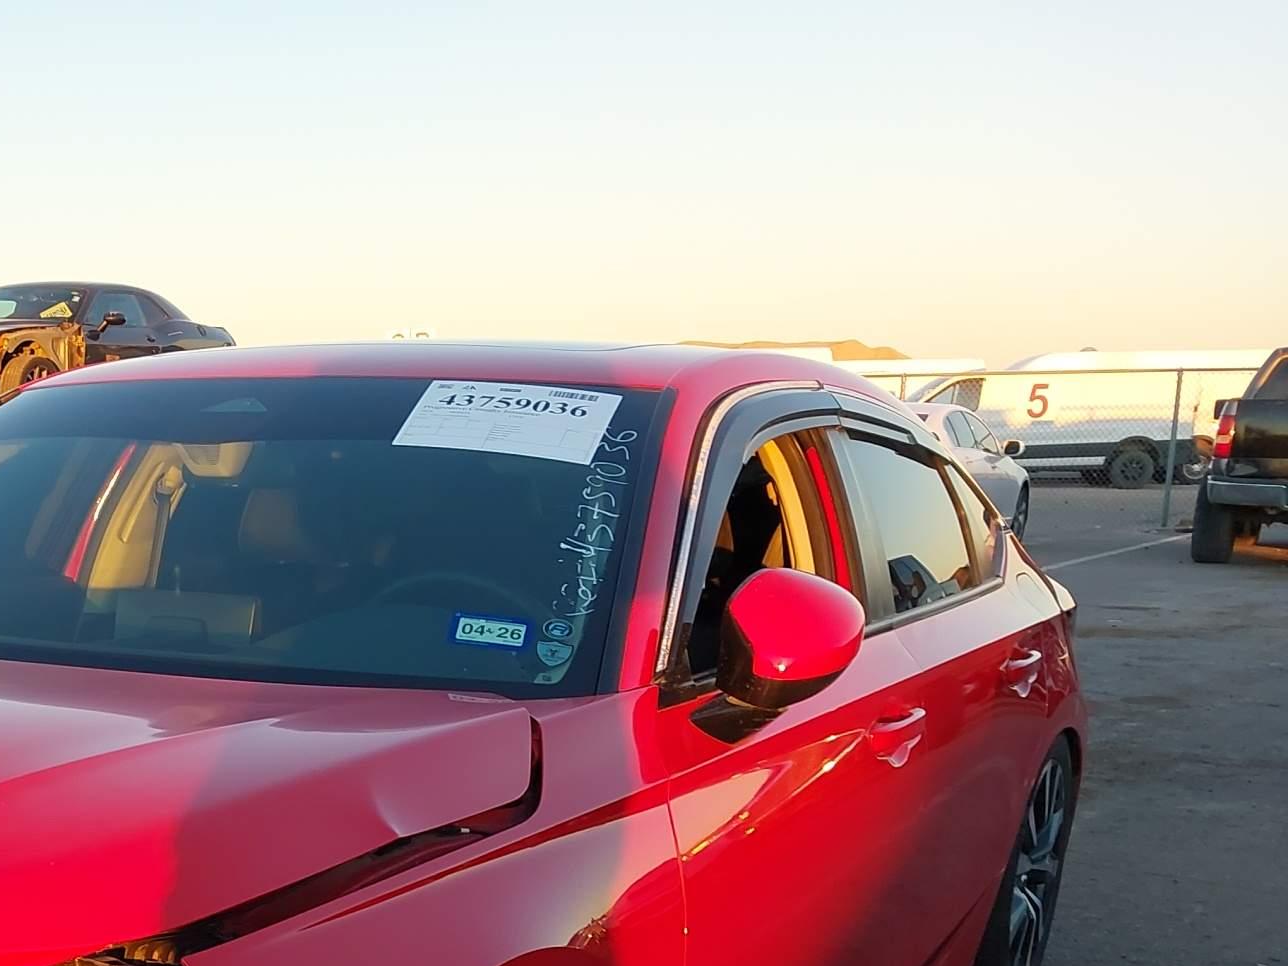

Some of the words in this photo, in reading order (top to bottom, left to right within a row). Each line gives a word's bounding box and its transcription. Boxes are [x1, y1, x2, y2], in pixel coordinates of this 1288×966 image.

[439, 394, 590, 418] 43759036
[1026, 383, 1050, 418] 5
[462, 623, 486, 637] 04
[496, 626, 523, 641] 26
